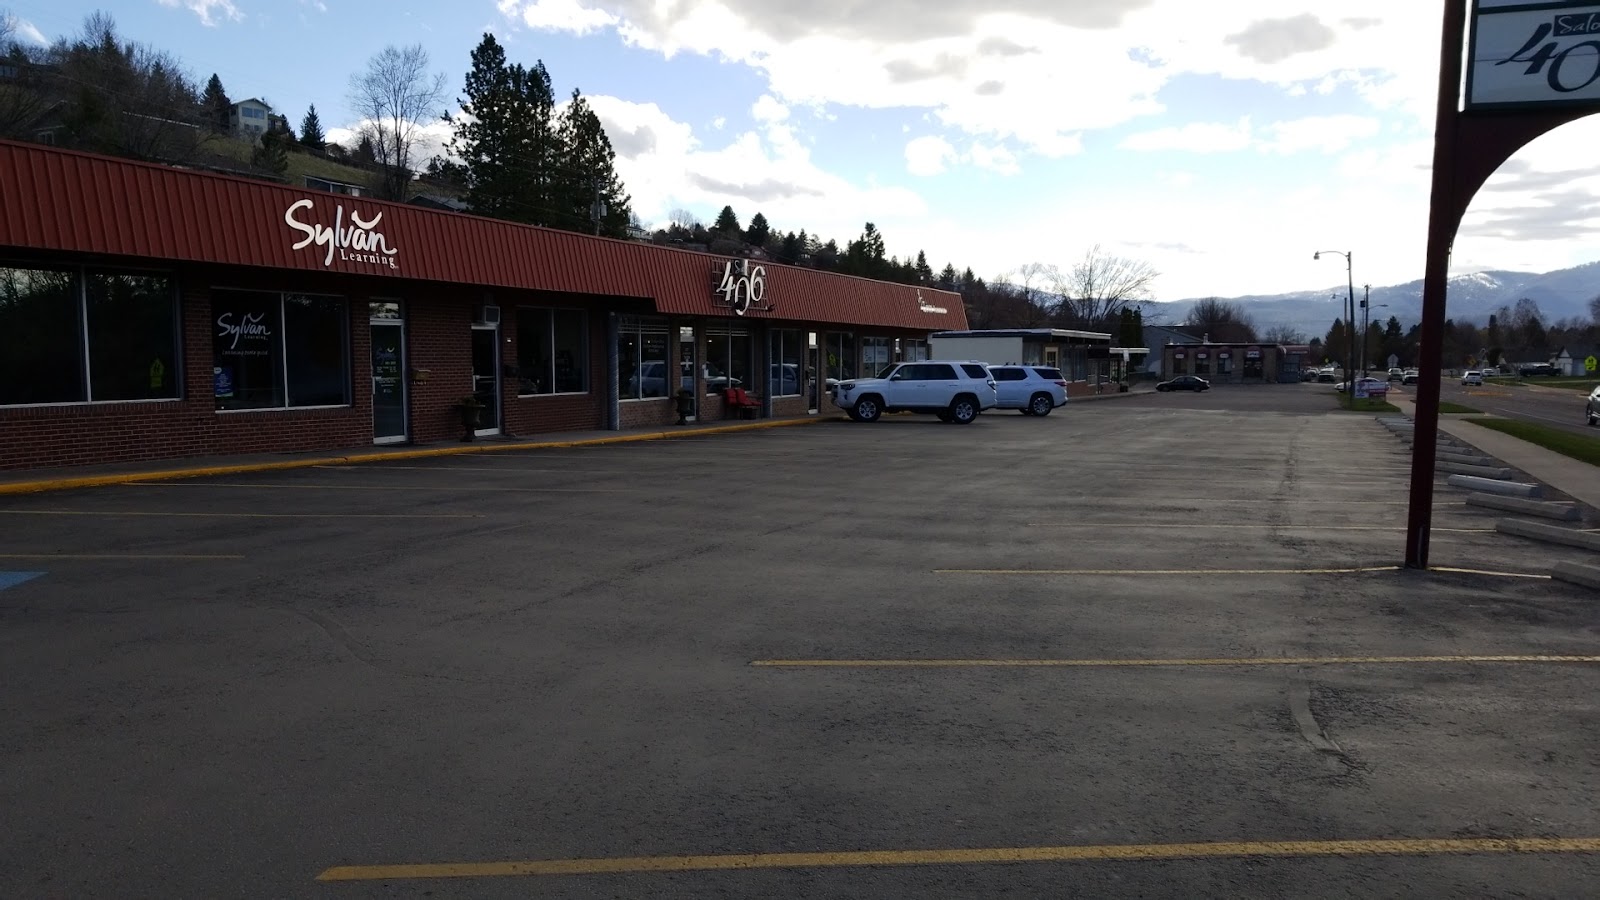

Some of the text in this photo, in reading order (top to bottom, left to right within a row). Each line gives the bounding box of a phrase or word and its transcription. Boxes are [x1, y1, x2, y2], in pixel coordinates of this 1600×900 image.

[284, 199, 398, 266] Sylvan
[339, 248, 396, 269] Learning
[715, 261, 766, 316] 406
[216, 312, 272, 349] Sylvan
